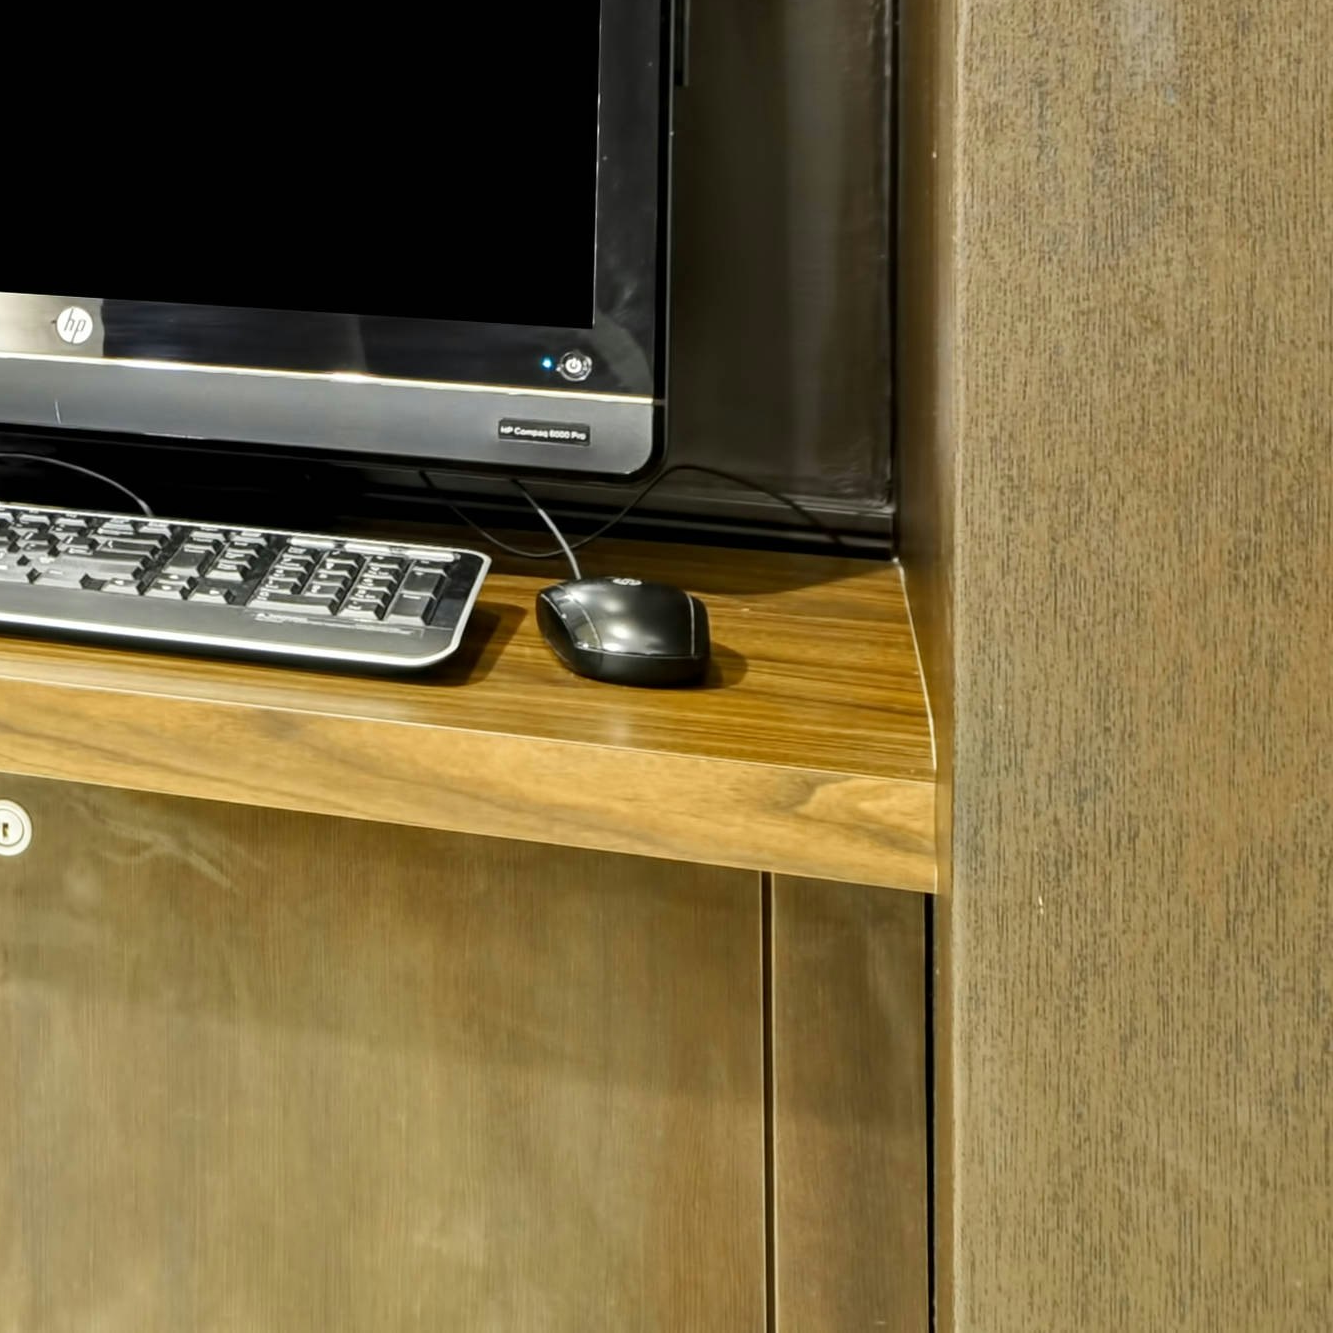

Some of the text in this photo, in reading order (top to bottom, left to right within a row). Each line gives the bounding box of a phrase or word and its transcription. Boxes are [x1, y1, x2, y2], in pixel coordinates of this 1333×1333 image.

[62, 306, 89, 344] hp
[500, 426, 513, 435] HP
[514, 427, 548, 438] Compaq
[571, 431, 586, 440] Pro
